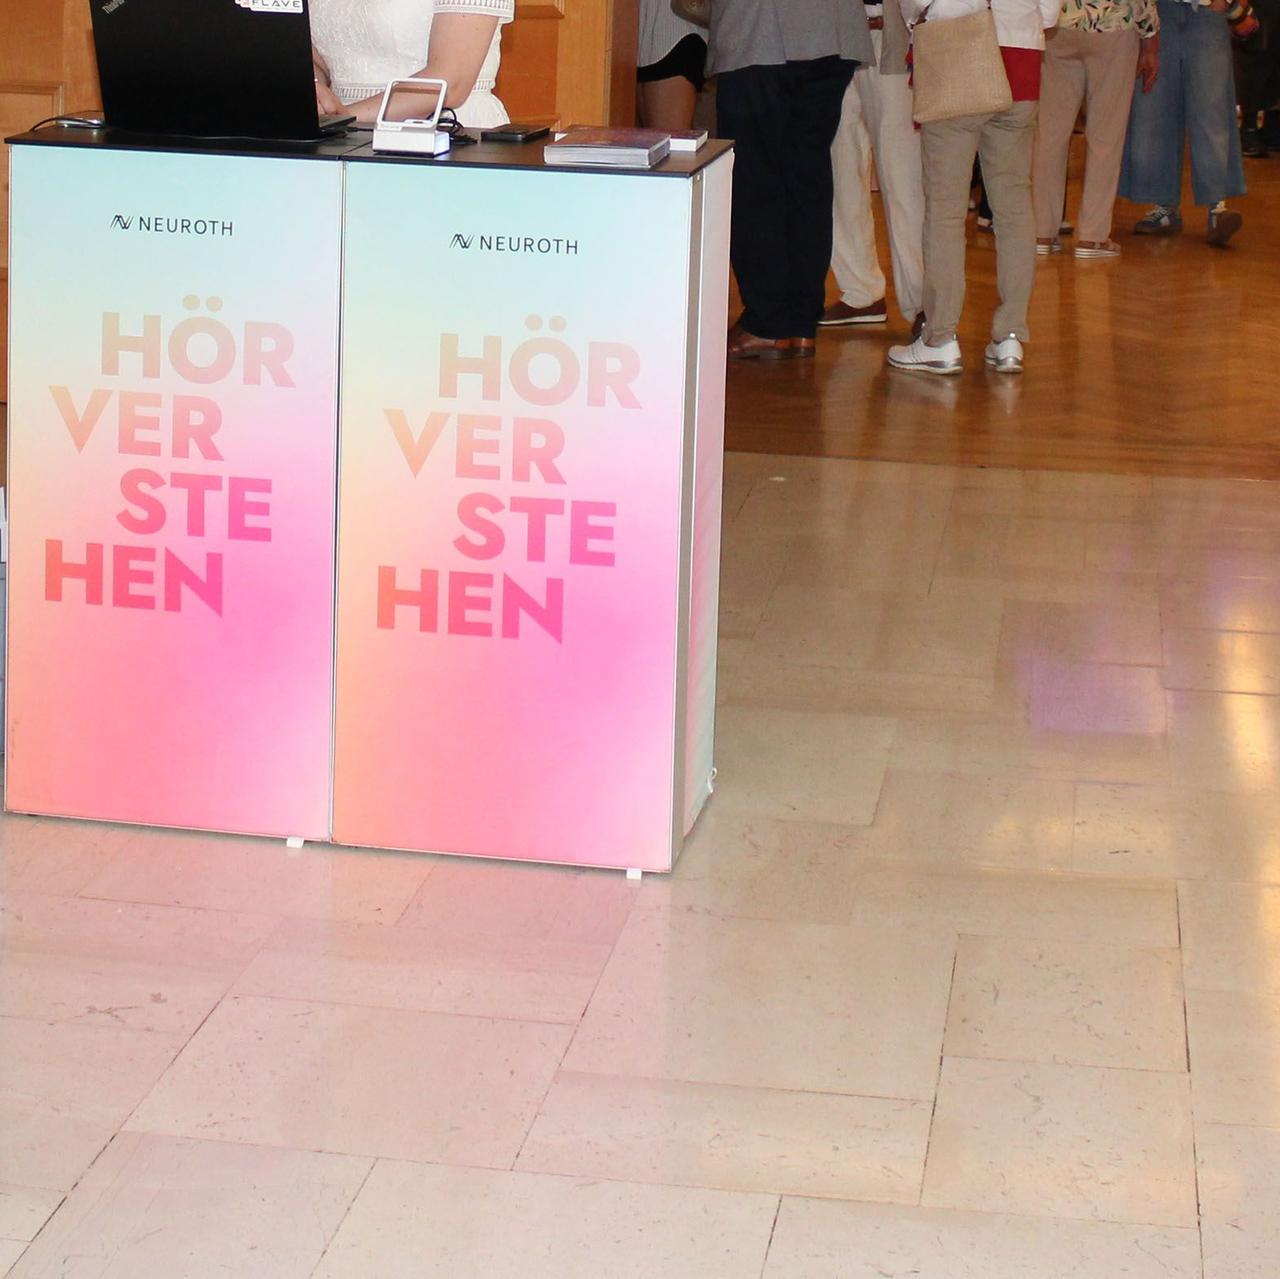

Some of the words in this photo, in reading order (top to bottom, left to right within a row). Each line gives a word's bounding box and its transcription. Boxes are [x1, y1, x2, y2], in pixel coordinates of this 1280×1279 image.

[138, 216, 234, 237] NEUROTH
[479, 234, 579, 256] NEUROTH
[100, 293, 297, 389] HÖR
[437, 313, 643, 410] HÖR
[48, 384, 225, 462] VER
[383, 407, 567, 486] VER
[115, 467, 273, 543] STE
[452, 492, 617, 568] STE
[43, 537, 224, 617] HEN
[376, 564, 565, 646] HEN
